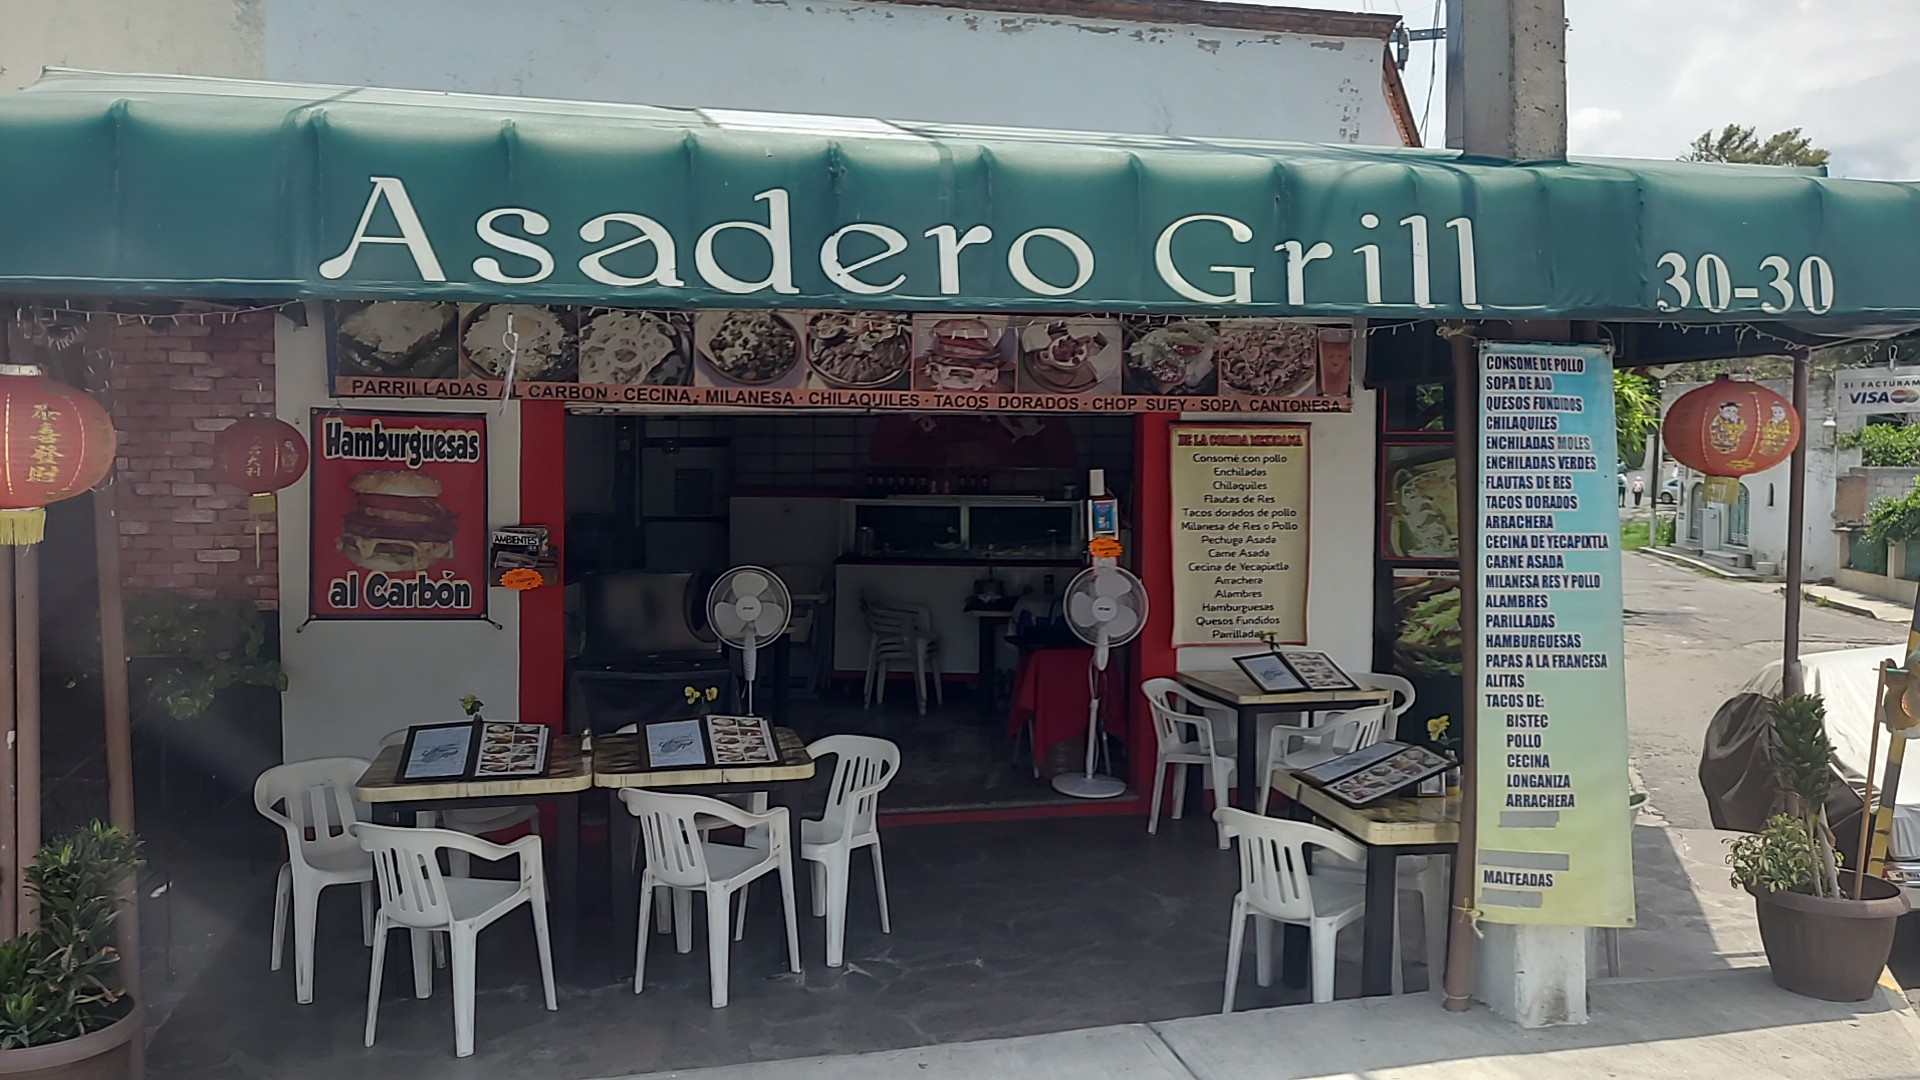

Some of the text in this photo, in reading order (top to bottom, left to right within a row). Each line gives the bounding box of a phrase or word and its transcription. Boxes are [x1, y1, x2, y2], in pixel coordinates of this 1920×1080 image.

[319, 176, 1483, 310] Asadero Grill
[1656, 252, 1834, 315] 30-30
[1486, 356, 1583, 373] CONSOME DE POLLO
[1486, 376, 1552, 391] SOPA DE AJO
[352, 379, 488, 397] PARRILLADAS
[529, 384, 608, 400] CARBON
[706, 389, 795, 405] MILANESA
[808, 391, 920, 408] CHILAQUILES
[934, 394, 989, 409] TACOS
[998, 396, 1079, 411] DORADOS
[1092, 397, 1137, 411] CHOP
[1146, 398, 1188, 412] SUEY
[1200, 399, 1242, 412] SOPA
[1250, 399, 1342, 413] CANTONESA
[1849, 391, 1889, 404] VISA
[1486, 396, 1582, 412] QUESOS FUNDIDOS
[1486, 416, 1557, 430] CHILAQUILES
[324, 420, 479, 467] Hamburguesas
[1486, 436, 1554, 450] ENCHILADAS
[1193, 453, 1287, 465] Consomé con pollo
[1486, 456, 1596, 470] ENCHILADAS VERDES
[1214, 467, 1267, 477] Enchiladas
[1213, 481, 1268, 491] Chilaquiles
[1486, 476, 1571, 489] FLAUTAS DE RES
[1204, 495, 1275, 504] Flautas de Res
[1486, 496, 1577, 509] TACOS DORADOS
[1182, 508, 1297, 519] Tacos dorados de pollo
[1181, 522, 1226, 531] Milanesa
[1228, 522, 1240, 531] de
[1242, 522, 1261, 531] Res
[1272, 522, 1298, 531] Pollo
[1486, 515, 1553, 529] ARRACHERA
[1201, 535, 1277, 546] Pechuga Asada
[1486, 535, 1609, 549] CECINA DE YECAPIXTLA
[1208, 549, 1270, 558] Carne Asada
[1188, 562, 1289, 573] Cecina de Yecapixtla
[1486, 555, 1563, 568] CARNE ASADA
[1214, 576, 1264, 585] Arrachera
[1486, 575, 1600, 588] MILANESA RES Y POLLO
[330, 574, 357, 606] al
[366, 571, 471, 607] Carbón
[1214, 589, 1263, 598] Alambres
[1202, 603, 1275, 613] Hamburguesas
[1486, 595, 1548, 608] ALAMBRES
[1196, 616, 1280, 626] Quesos Fundidos
[1486, 614, 1555, 628] PARILLADAS
[1486, 634, 1581, 648] HAMBURGUESAS
[1486, 654, 1607, 668] PAPAS A LA FRANCESA
[1486, 674, 1524, 688] ALITAS
[1486, 694, 1544, 708] TACOS DE:
[1507, 714, 1548, 728] BISTEC
[1507, 734, 1542, 748] POLLO
[1507, 754, 1550, 768] CECINA
[1507, 774, 1570, 788] LONGANIZA
[1506, 794, 1575, 808] ARRACHERA
[1484, 870, 1553, 887] MALTEADAS
